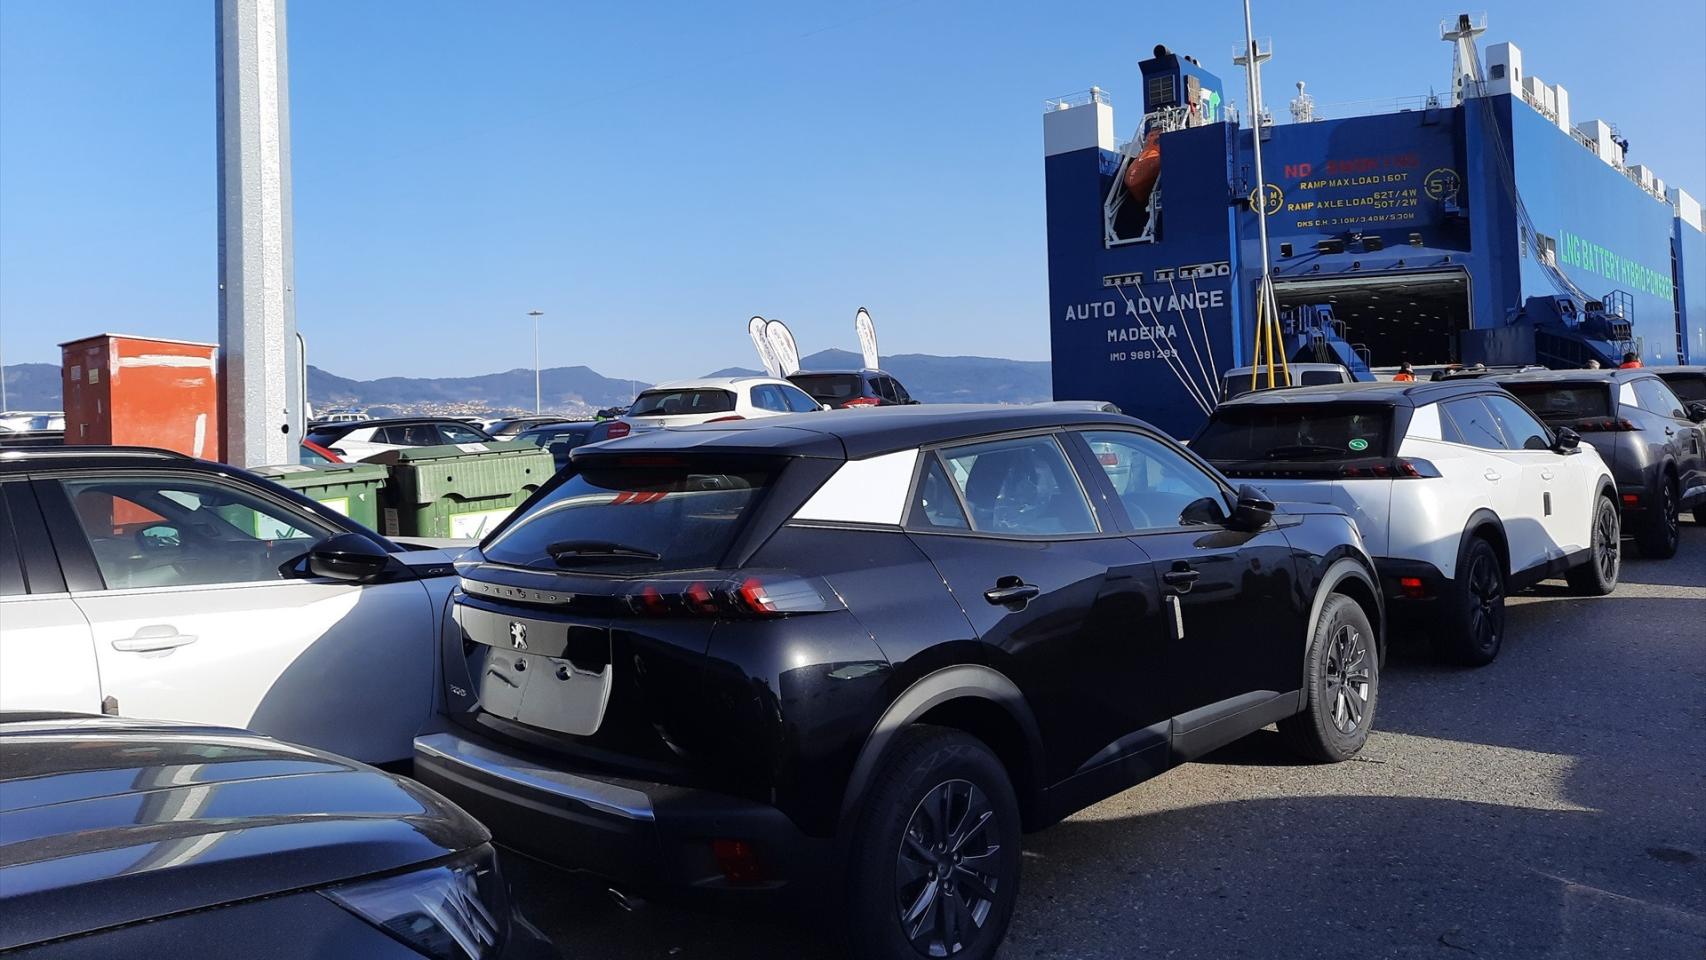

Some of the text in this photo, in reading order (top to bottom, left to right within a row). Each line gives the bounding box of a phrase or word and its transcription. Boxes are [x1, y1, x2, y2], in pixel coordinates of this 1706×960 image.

[1300, 180, 1326, 190] RAMP
[1329, 178, 1349, 187] MAX
[1351, 175, 1380, 185] LOAD
[1287, 197, 1373, 212] RAMP AXLE LOAD
[1560, 229, 1580, 267] LNG
[1582, 239, 1619, 282] BATTERY
[1621, 256, 1645, 293] HYBRID
[1065, 290, 1224, 321] AUTO ADVANCE
[1107, 324, 1177, 343] MADEIRA
[1110, 352, 1126, 361] IMO
